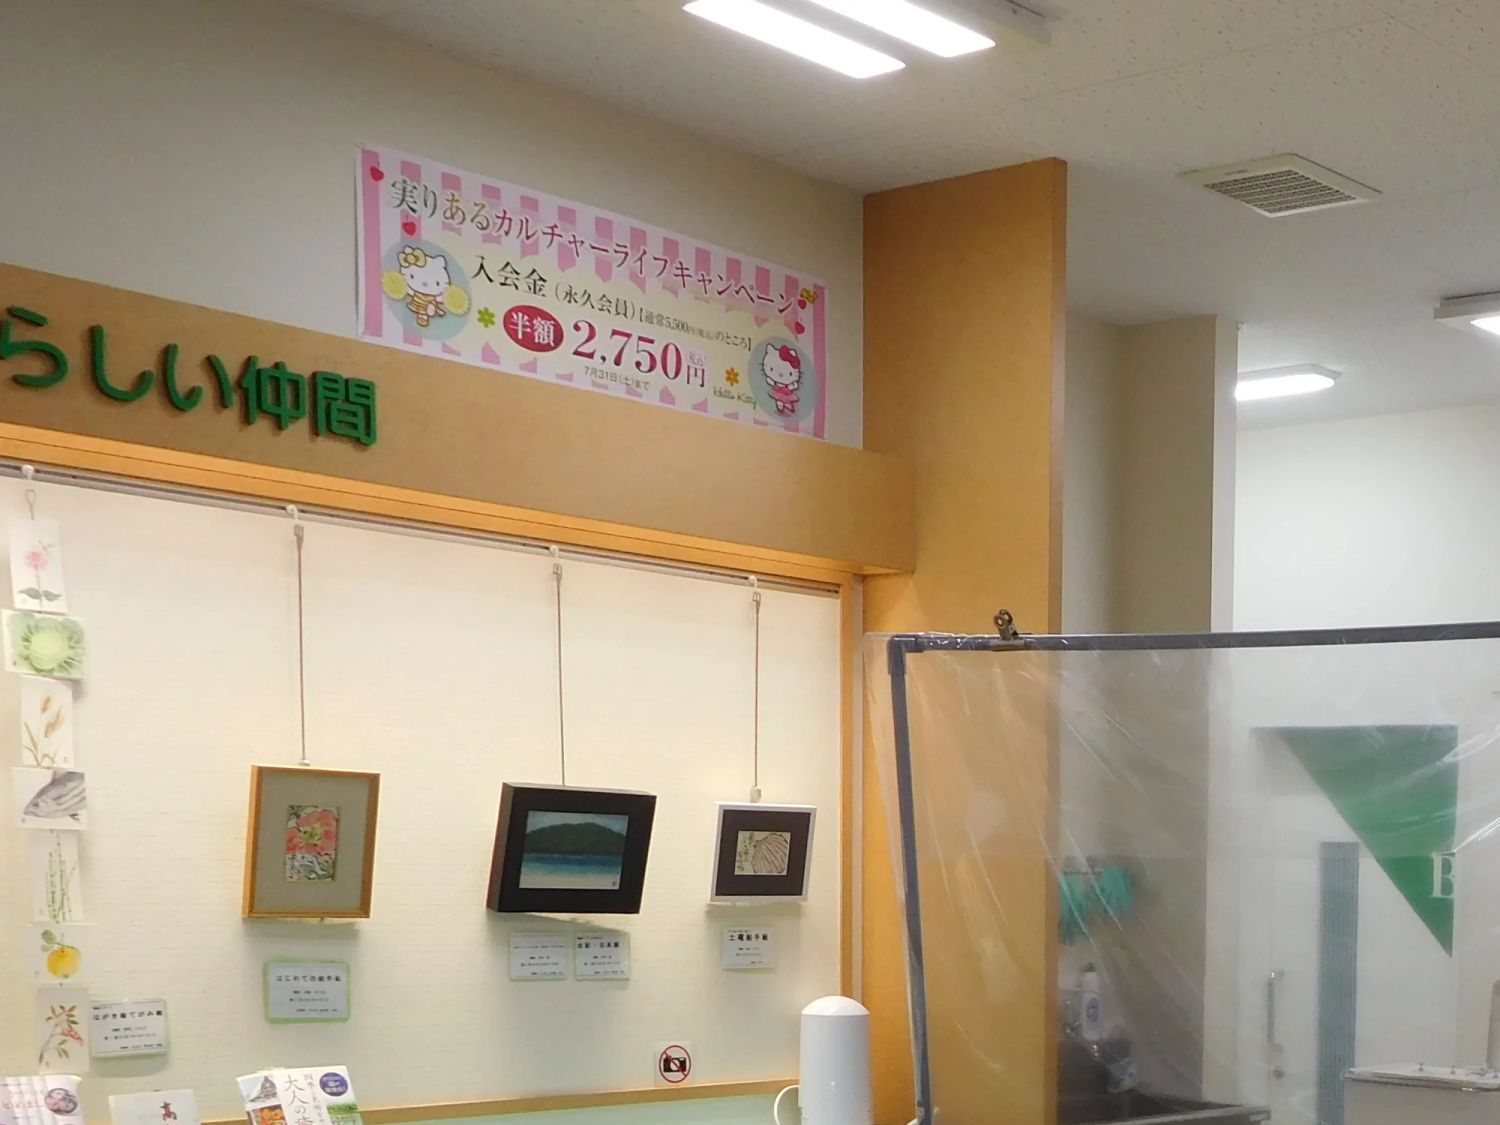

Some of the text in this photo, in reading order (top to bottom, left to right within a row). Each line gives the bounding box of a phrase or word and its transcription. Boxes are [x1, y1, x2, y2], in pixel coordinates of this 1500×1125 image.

[391, 178, 797, 314] 実りあるカルチャーライフキャンペーン
[470, 254, 548, 299] 入会金
[509, 312, 558, 348] 半額
[0, 305, 378, 446] らしい仲間
